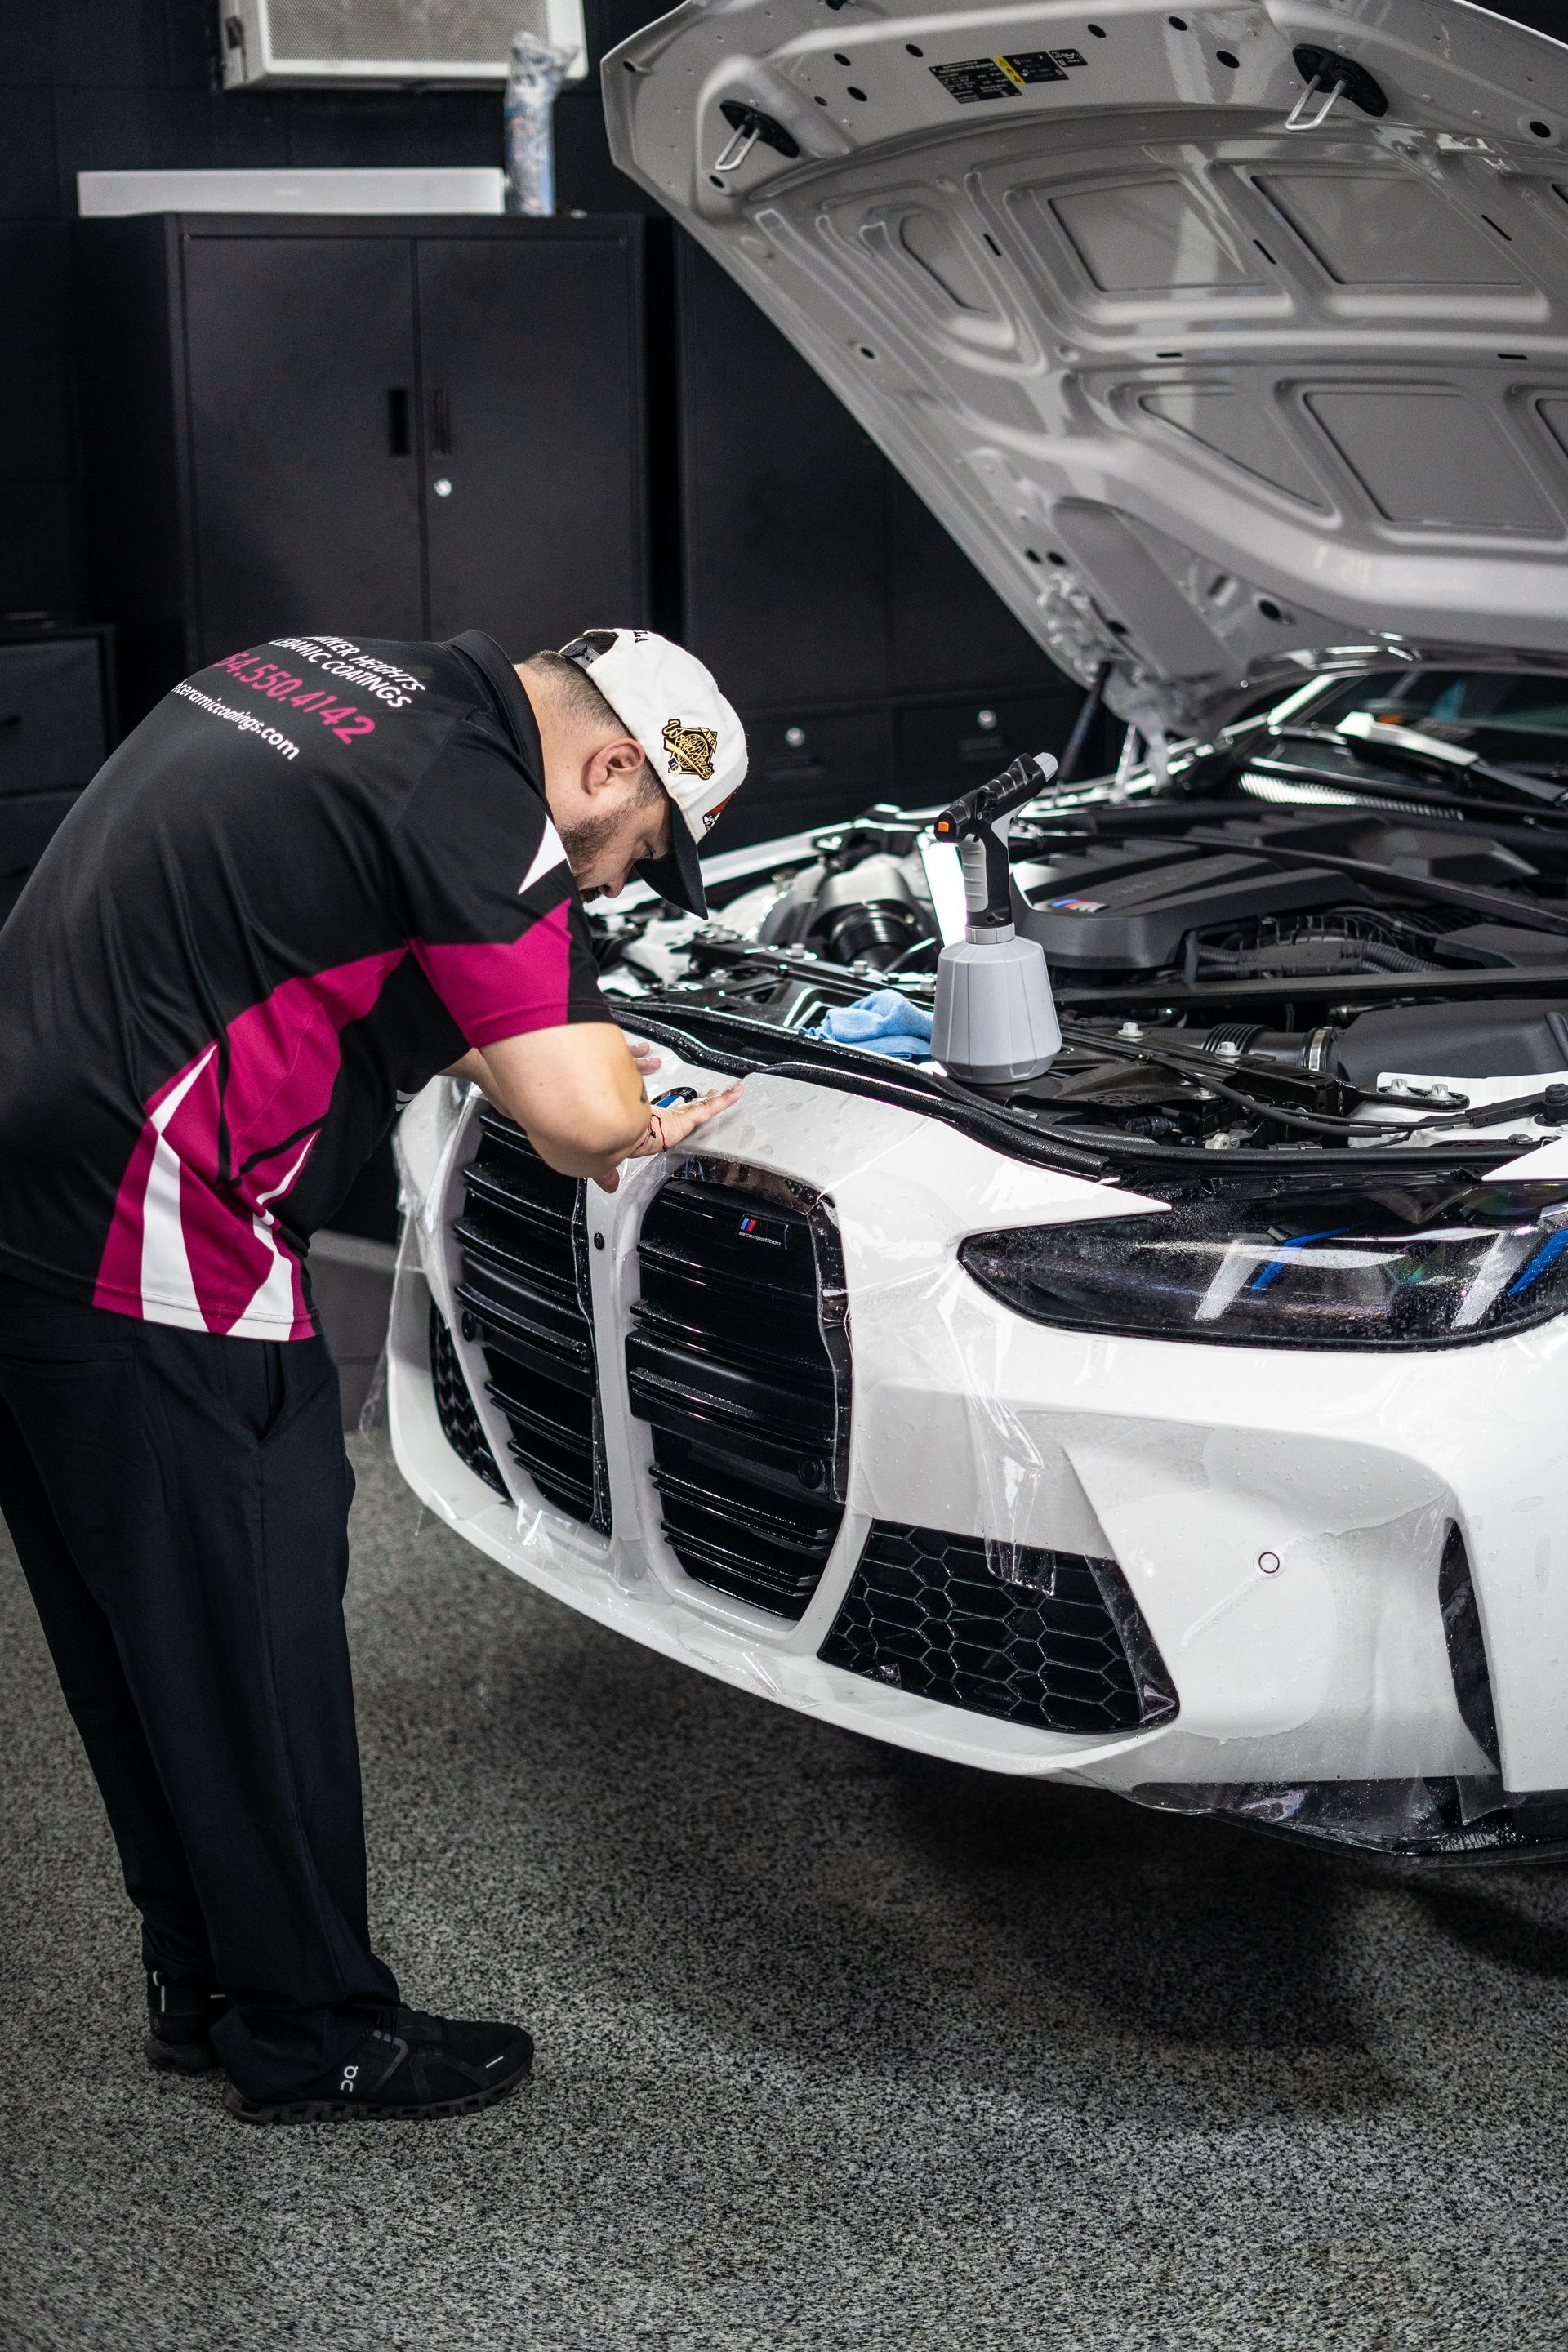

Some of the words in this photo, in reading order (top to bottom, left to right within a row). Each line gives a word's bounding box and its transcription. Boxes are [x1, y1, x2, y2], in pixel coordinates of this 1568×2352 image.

[269, 638, 332, 662] CERAMIC
[321, 661, 412, 708] COATINGS
[349, 655, 425, 693] HEIGHTS
[662, 719, 698, 752] World
[745, 1233, 781, 1245] competition
